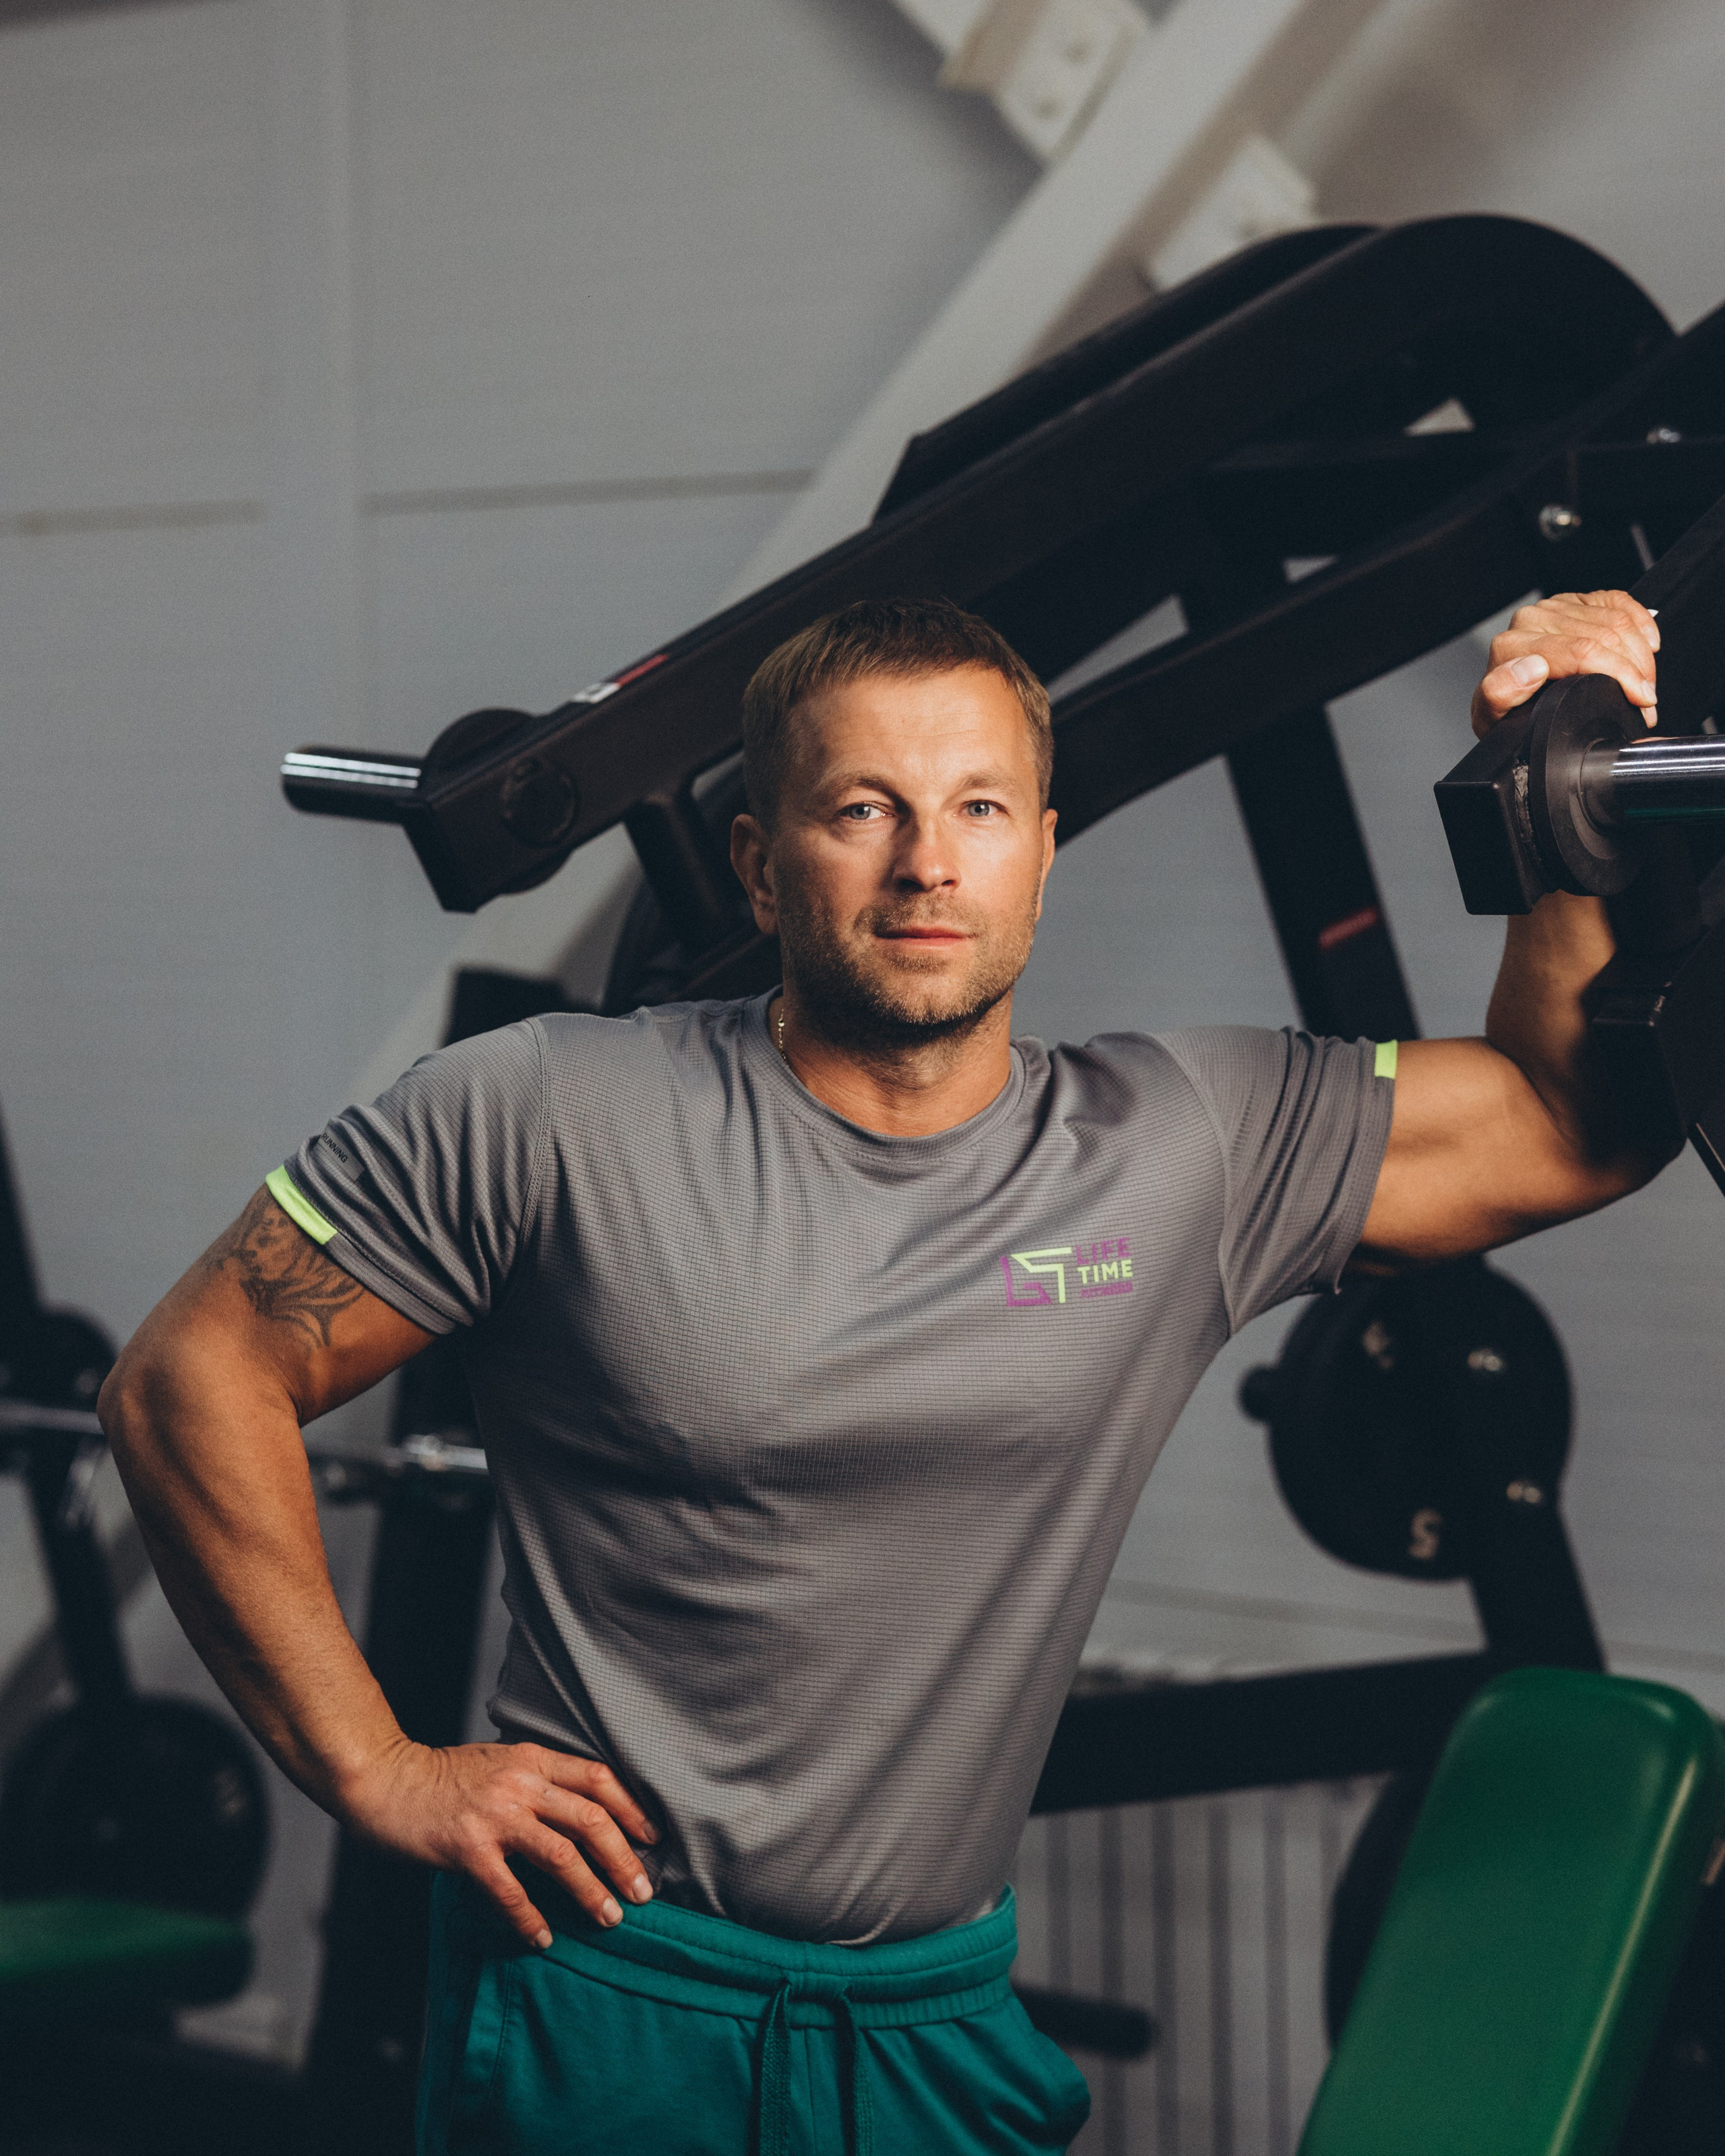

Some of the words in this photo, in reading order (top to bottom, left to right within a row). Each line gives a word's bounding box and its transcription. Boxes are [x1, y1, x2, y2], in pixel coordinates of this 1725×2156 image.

[321, 1133, 348, 1163] RUNNING
[1076, 1238, 1131, 1264] LIFE
[1077, 1259, 1133, 1284] TIME
